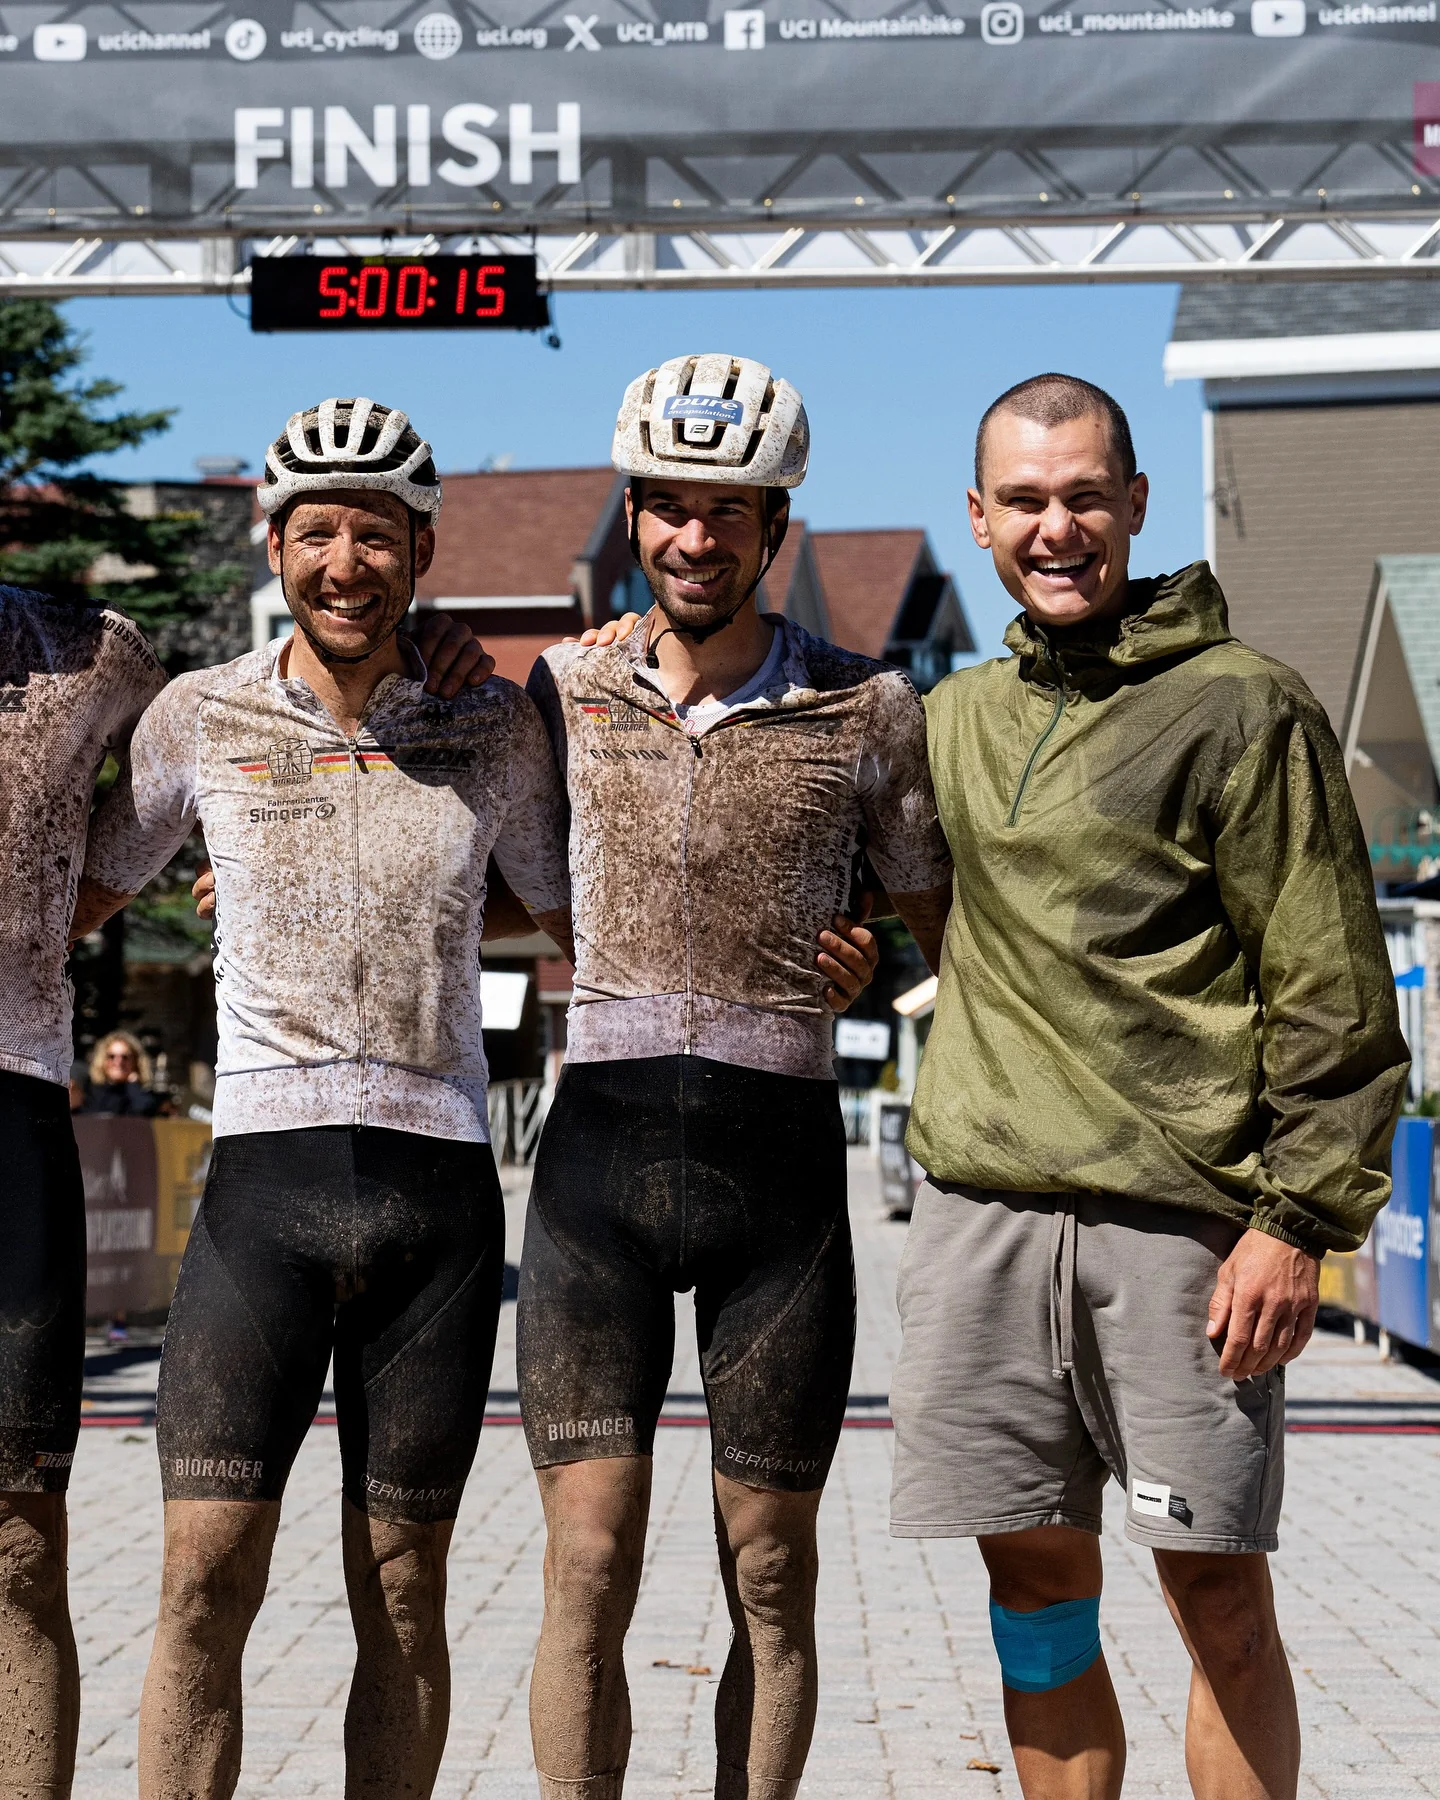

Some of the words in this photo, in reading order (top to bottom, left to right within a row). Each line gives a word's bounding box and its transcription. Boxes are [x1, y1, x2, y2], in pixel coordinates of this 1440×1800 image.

[98, 29, 210, 51] ucichannel
[280, 26, 400, 52] uci_cycling
[476, 25, 548, 49] uci.org
[616, 22, 709, 46] UCI_MTB
[779, 18, 816, 39] UCI
[819, 17, 966, 38] Mountainbike
[1039, 9, 1236, 36] uci_mountainbike
[1318, 2, 1437, 26] ucichannel
[234, 102, 581, 188] FINISH
[319, 266, 505, 317] 5:00:15
[670, 398, 738, 411] pure
[611, 723, 649, 732] BIORACER
[589, 748, 669, 761] CANYON
[250, 807, 313, 825] Singer
[548, 1417, 635, 1442] BIORACER
[175, 1457, 263, 1479] BIORACER
[724, 1446, 821, 1474] GERMANY
[360, 1473, 453, 1501] GERMANY
